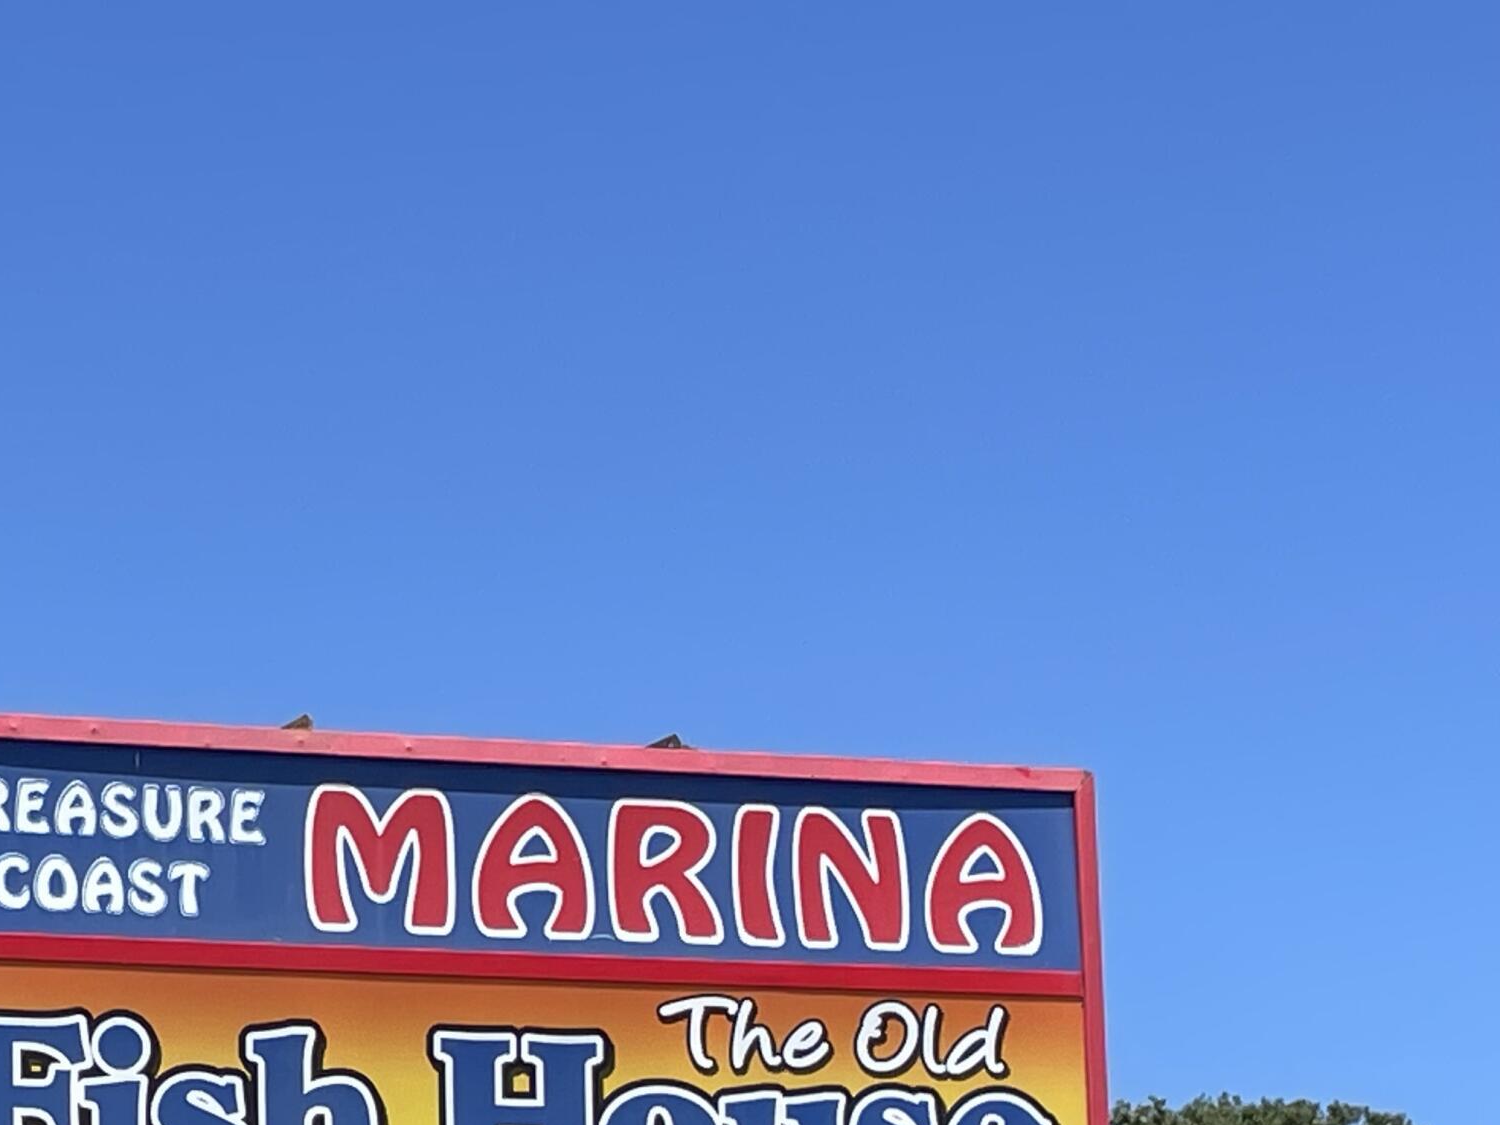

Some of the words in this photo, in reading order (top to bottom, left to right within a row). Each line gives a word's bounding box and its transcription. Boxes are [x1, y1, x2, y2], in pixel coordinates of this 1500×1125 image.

[305, 783, 1043, 955] MARINA
[658, 994, 832, 1073] The
[854, 1000, 1010, 1081] Old
